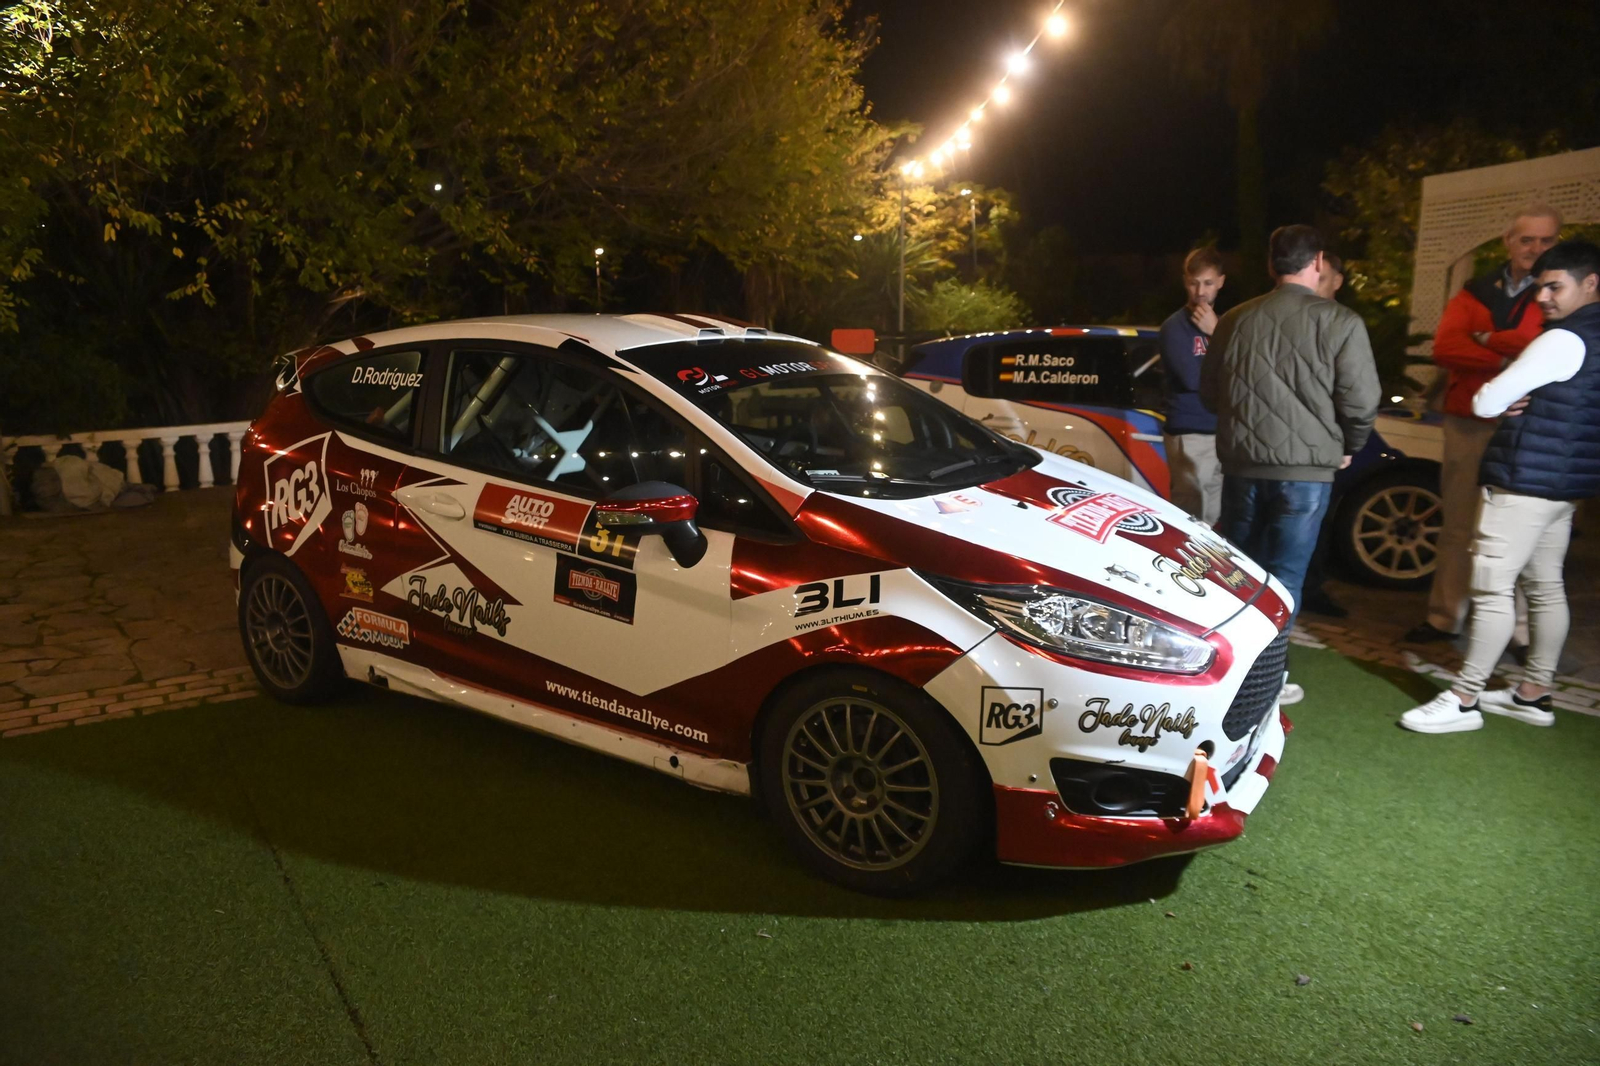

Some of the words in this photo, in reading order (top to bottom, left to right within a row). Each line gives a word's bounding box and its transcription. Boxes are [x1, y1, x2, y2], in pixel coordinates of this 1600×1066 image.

[1015, 354, 1075, 367] R.M.Saco
[351, 366, 423, 390] D.Rodríguez
[1012, 371, 1099, 384] M.A.Calderon
[271, 460, 320, 530] RG3
[506, 494, 555, 517] AUTO
[501, 508, 549, 529] SPORT
[514, 531, 534, 542] SUBIDA
[539, 537, 573, 551] TRASSIERRA
[408, 575, 454, 614] Jade
[571, 572, 593, 588] TIENDA
[595, 579, 618, 598] RALLYE
[356, 611, 406, 635] FORMULA
[795, 609, 879, 630] WWW.3LITHIUM.ES
[545, 680, 709, 743] www.tiendarallye.com
[986, 702, 1035, 729] RG3
[1078, 697, 1139, 733] Jade
[1140, 702, 1199, 740] Nails
[1118, 728, 1160, 753] lounge
